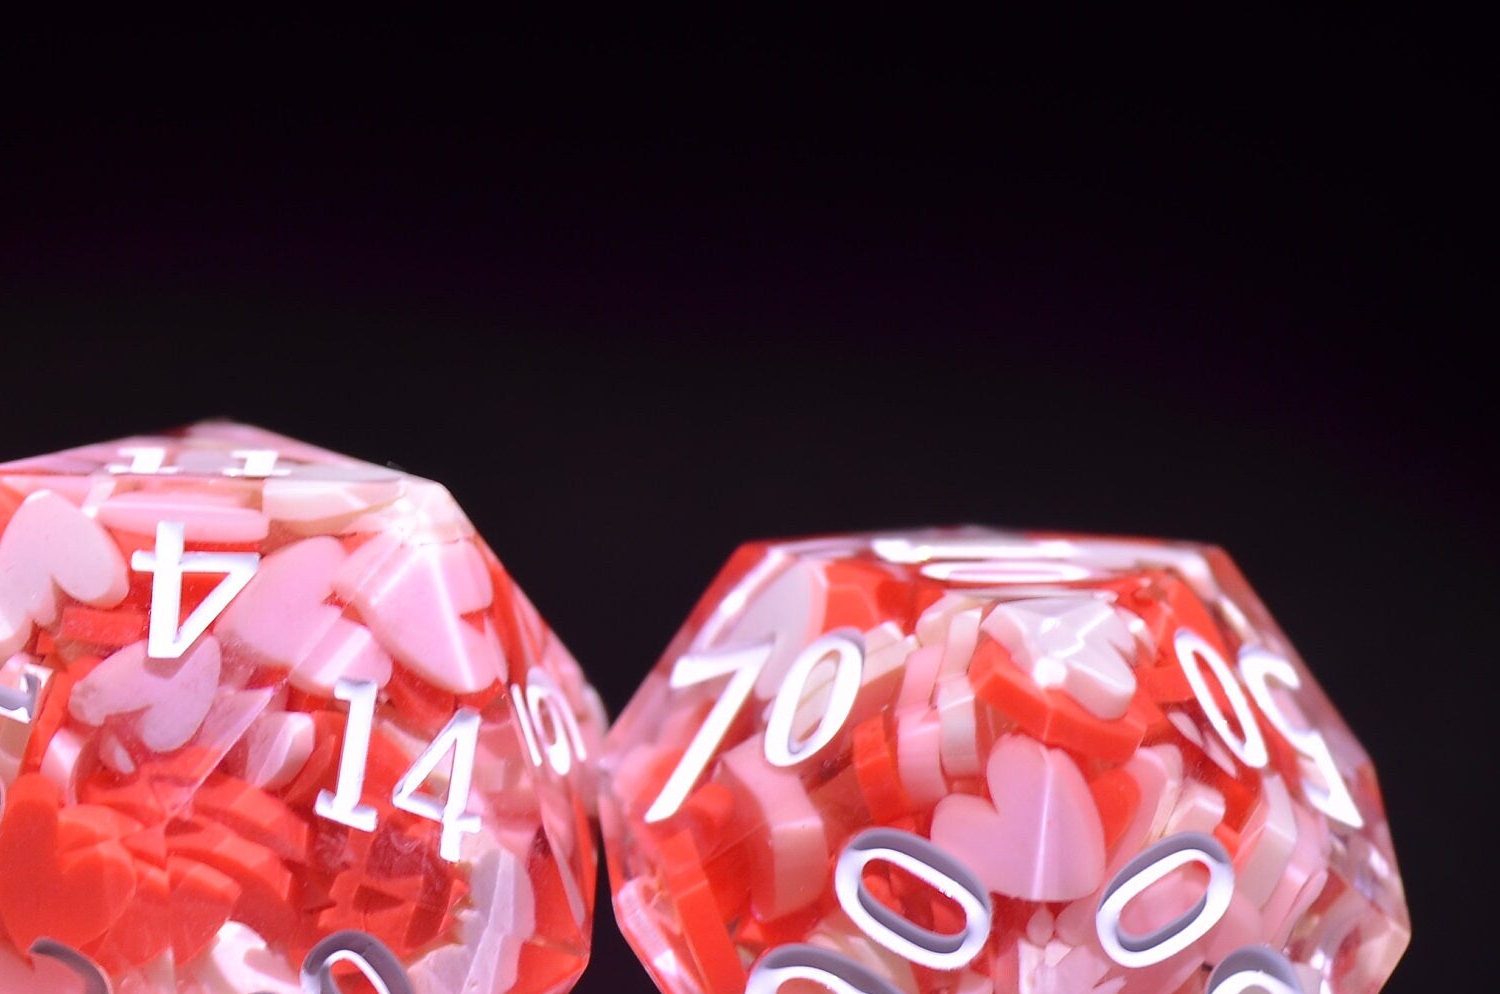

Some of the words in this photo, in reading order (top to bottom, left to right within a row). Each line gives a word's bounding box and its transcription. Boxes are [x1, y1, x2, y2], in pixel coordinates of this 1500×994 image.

[106, 446, 291, 477] 11
[131, 521, 260, 659] 4
[315, 677, 483, 862] 14
[644, 627, 864, 822] 70
[1173, 627, 1363, 827] 50
